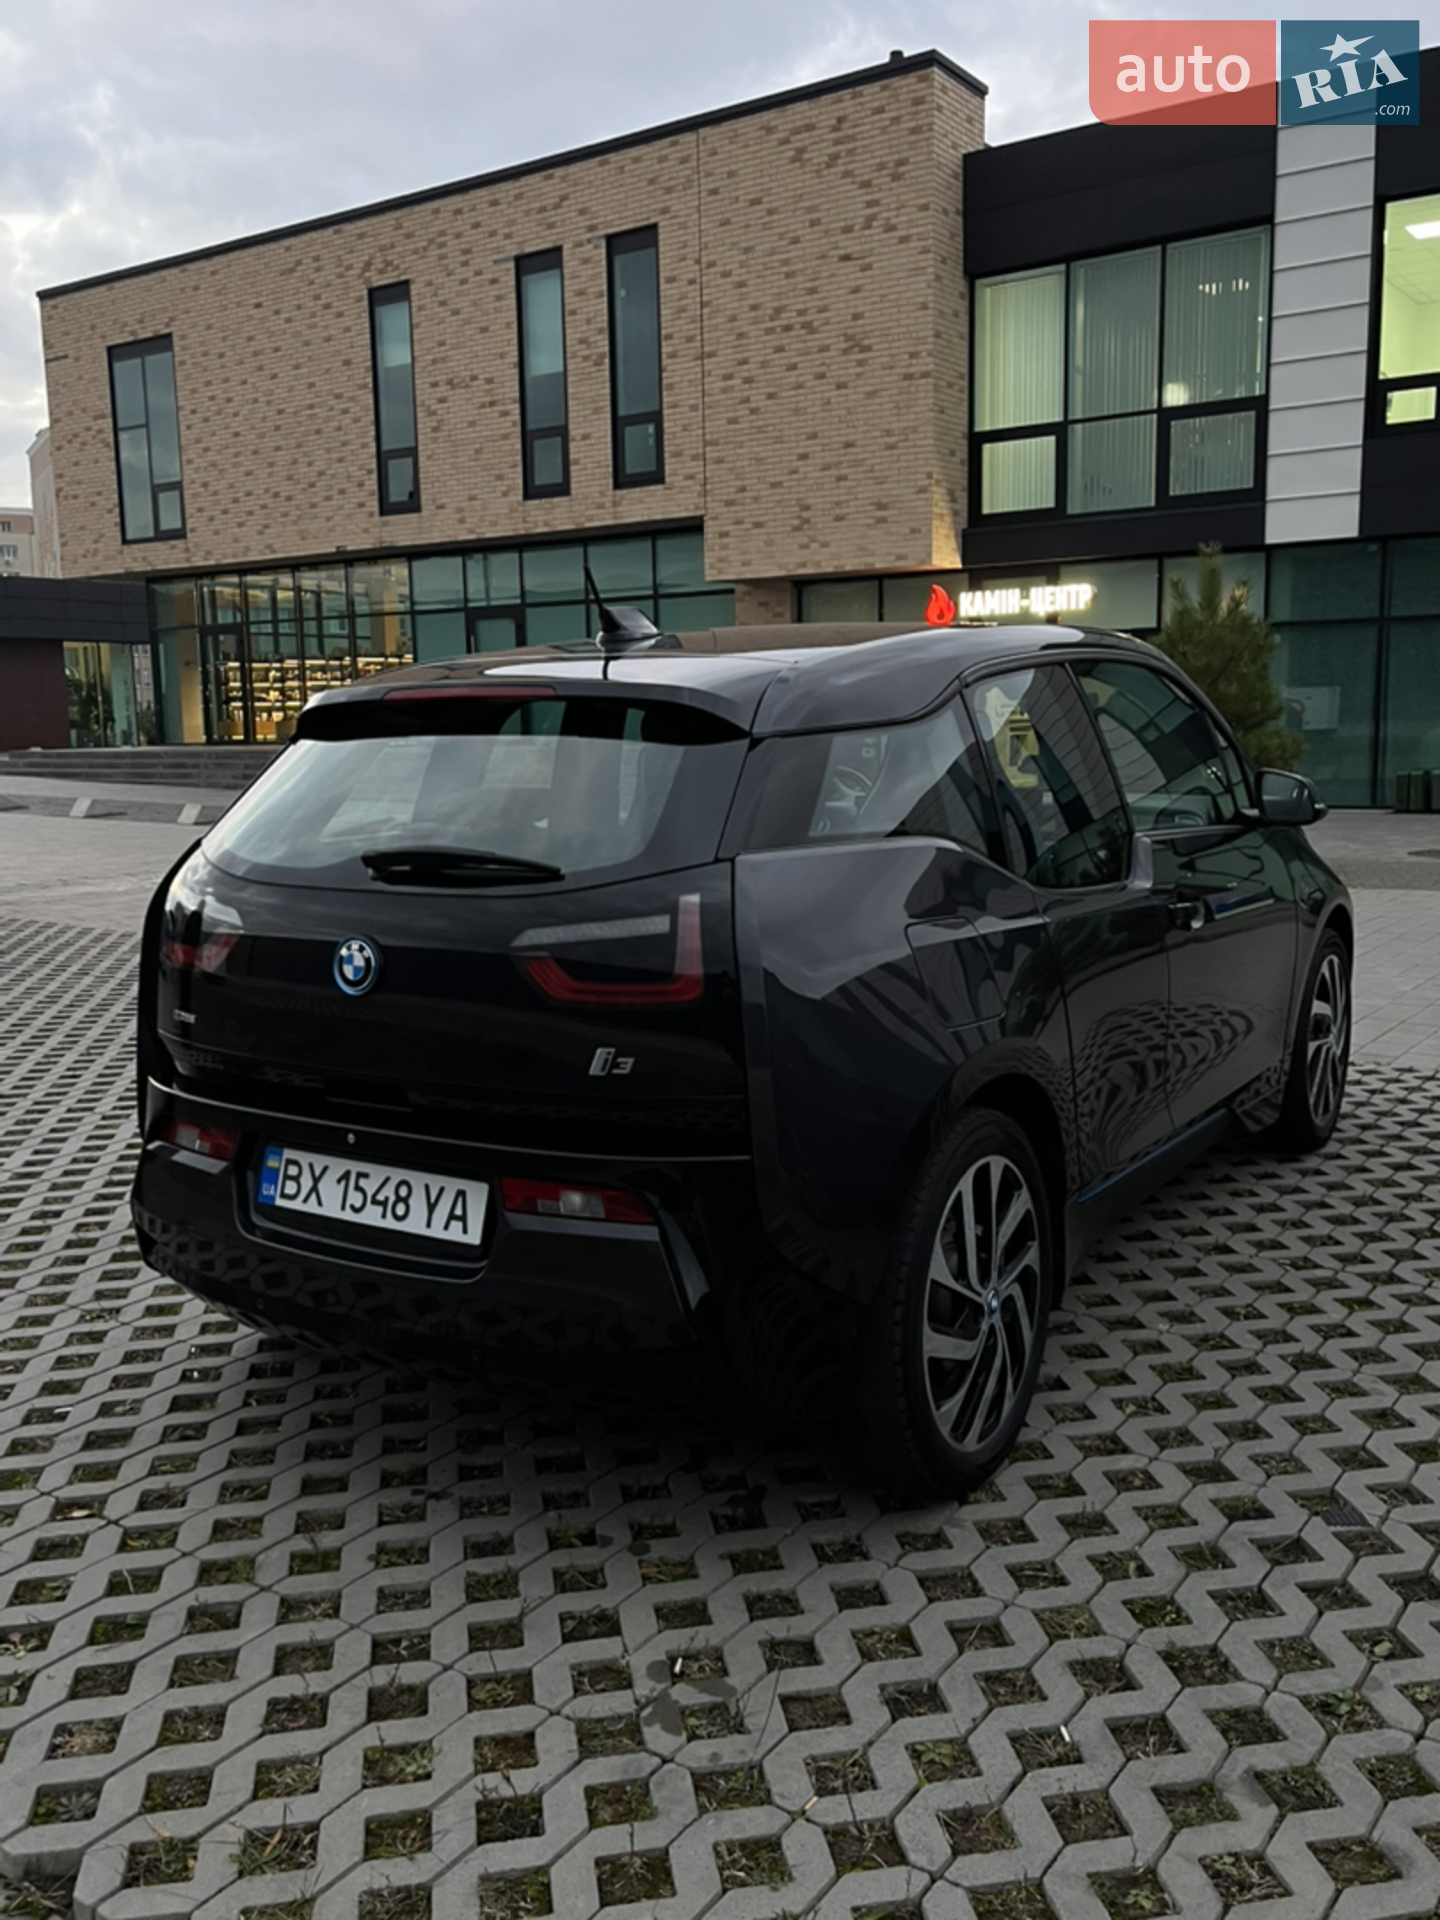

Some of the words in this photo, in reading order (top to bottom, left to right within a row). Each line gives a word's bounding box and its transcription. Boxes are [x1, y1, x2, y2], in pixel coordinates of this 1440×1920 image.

[960, 583, 1092, 616] КАМІН-ЦЕНТР
[588, 1047, 635, 1076] i3
[262, 1182, 275, 1196] UA
[279, 1157, 329, 1208] BX
[336, 1169, 412, 1222] 1548
[423, 1183, 469, 1235] YA
